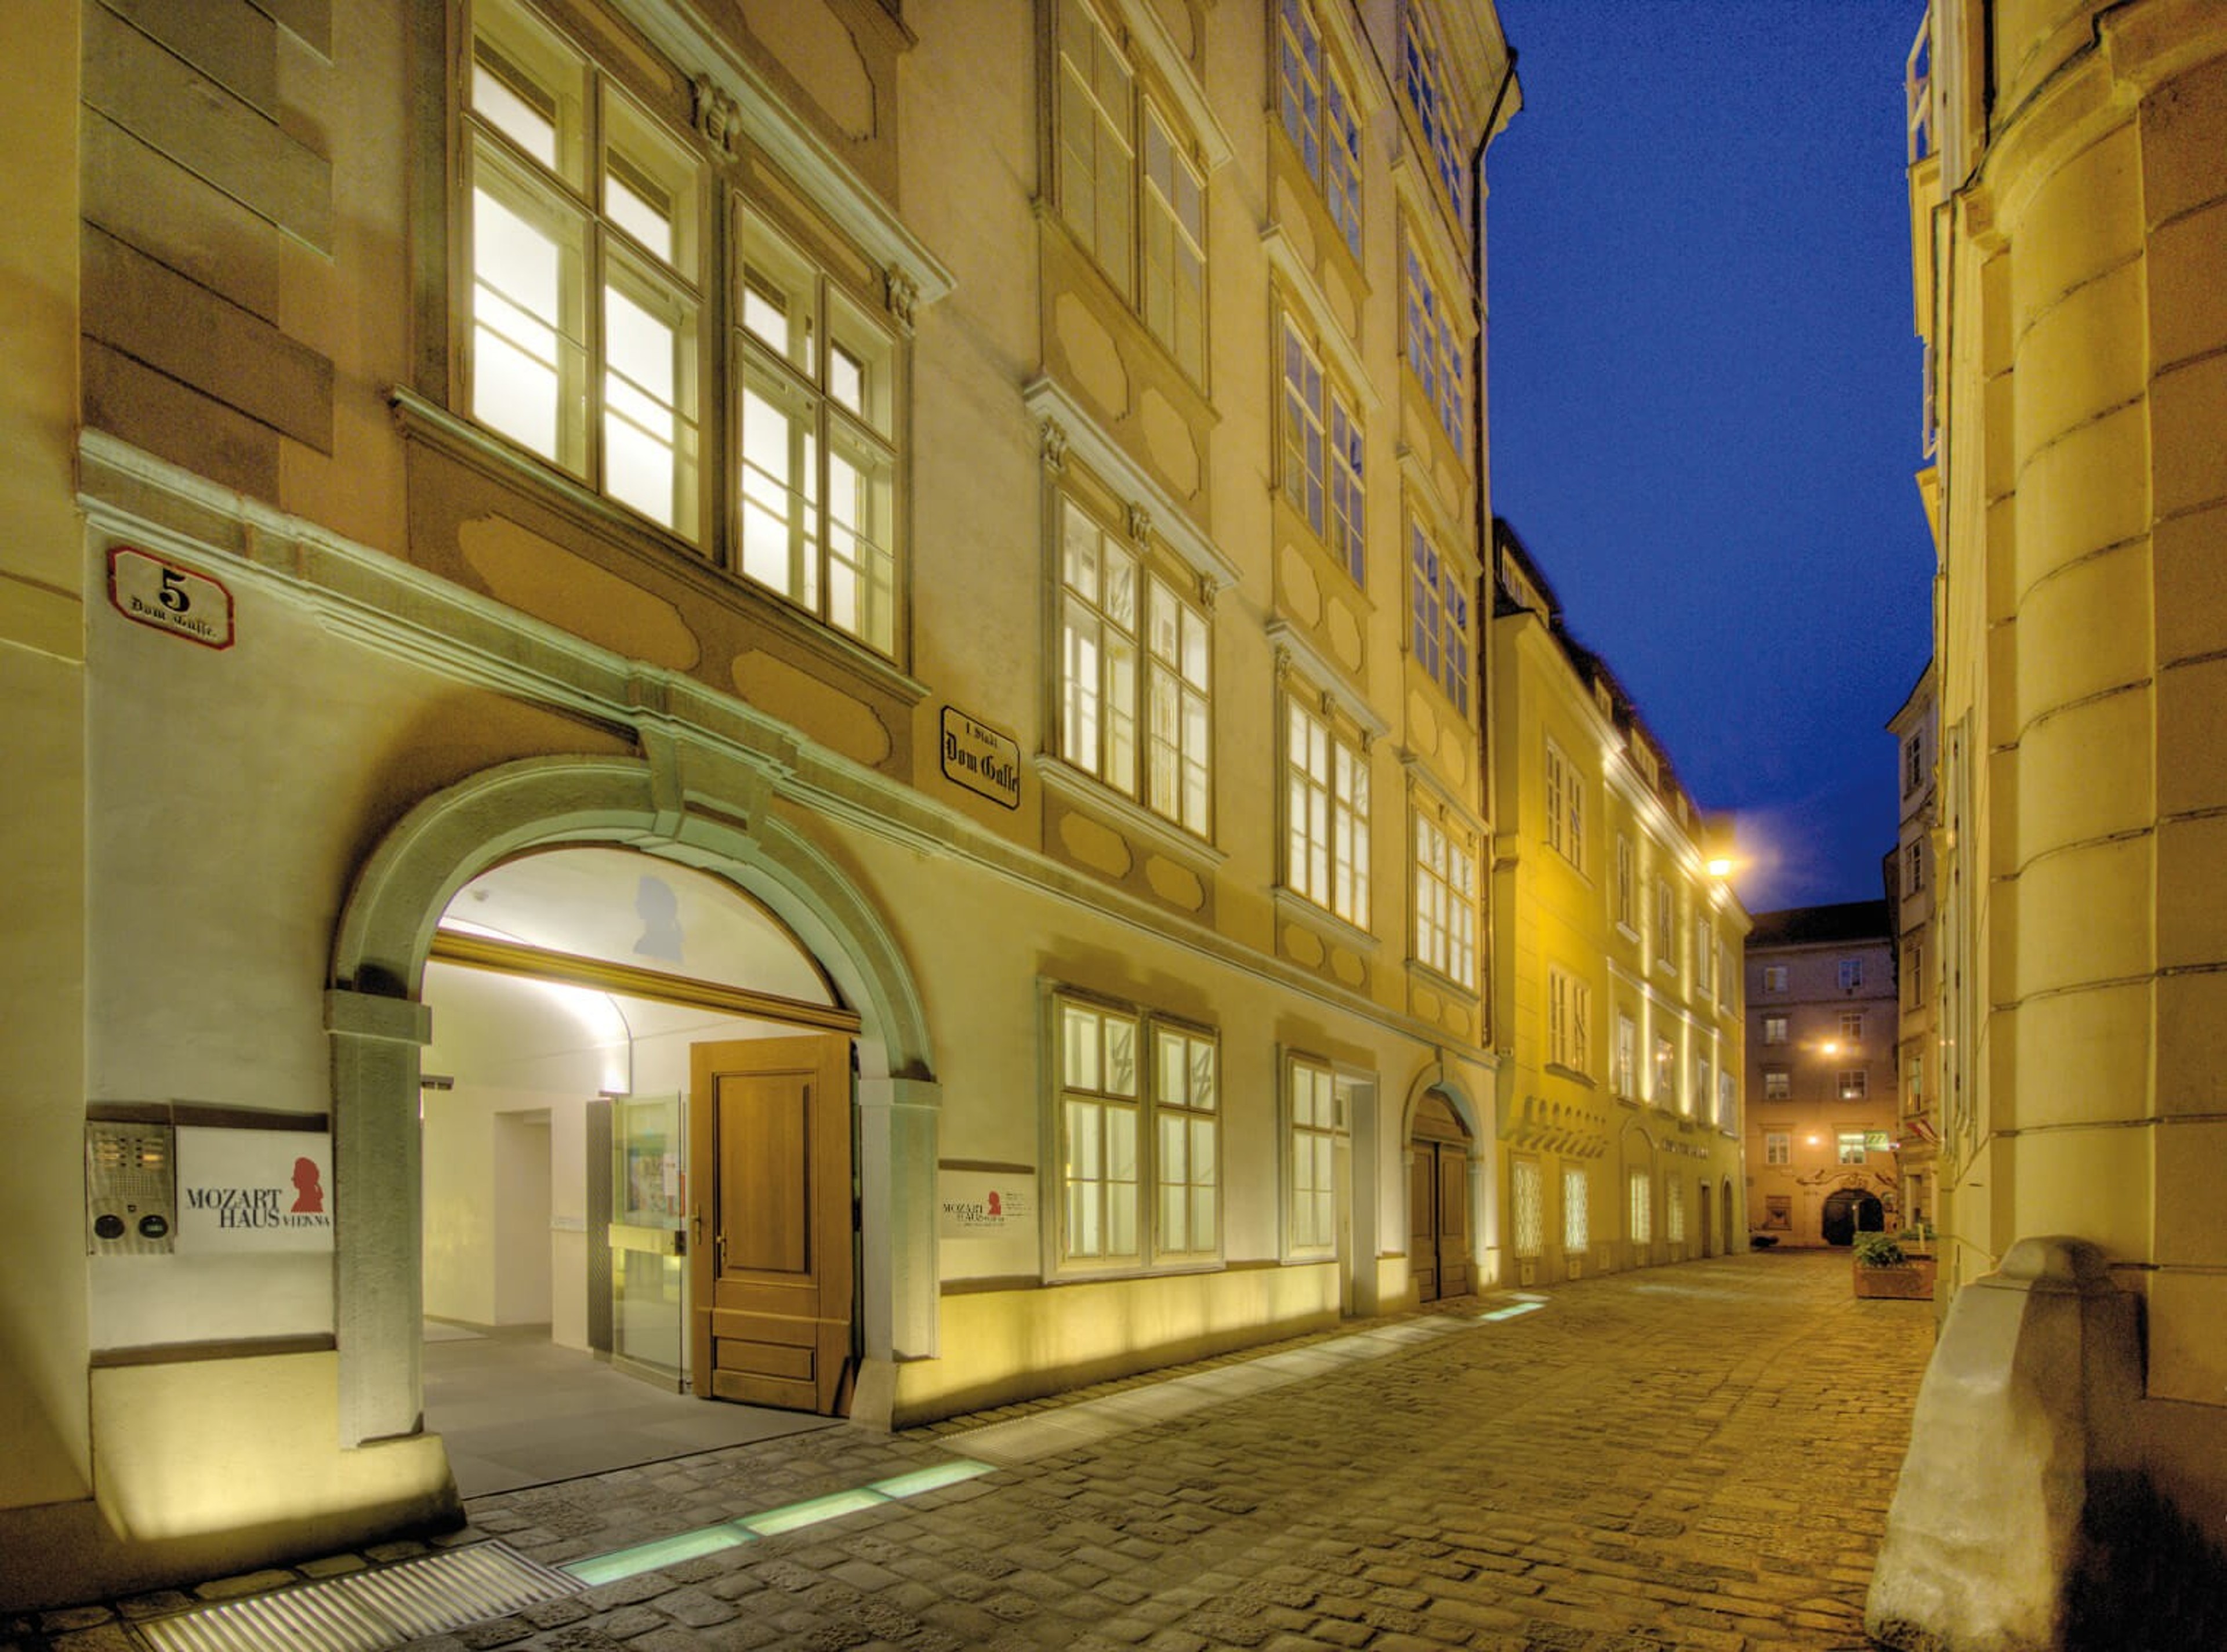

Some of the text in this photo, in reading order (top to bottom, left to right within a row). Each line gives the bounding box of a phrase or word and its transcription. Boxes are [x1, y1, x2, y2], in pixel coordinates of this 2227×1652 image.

[159, 567, 190, 613] 5
[132, 595, 165, 620] Dom
[946, 731, 977, 773] Dom
[186, 1188, 282, 1209] MOZART
[218, 1209, 330, 1228] HAUS VIENNA
